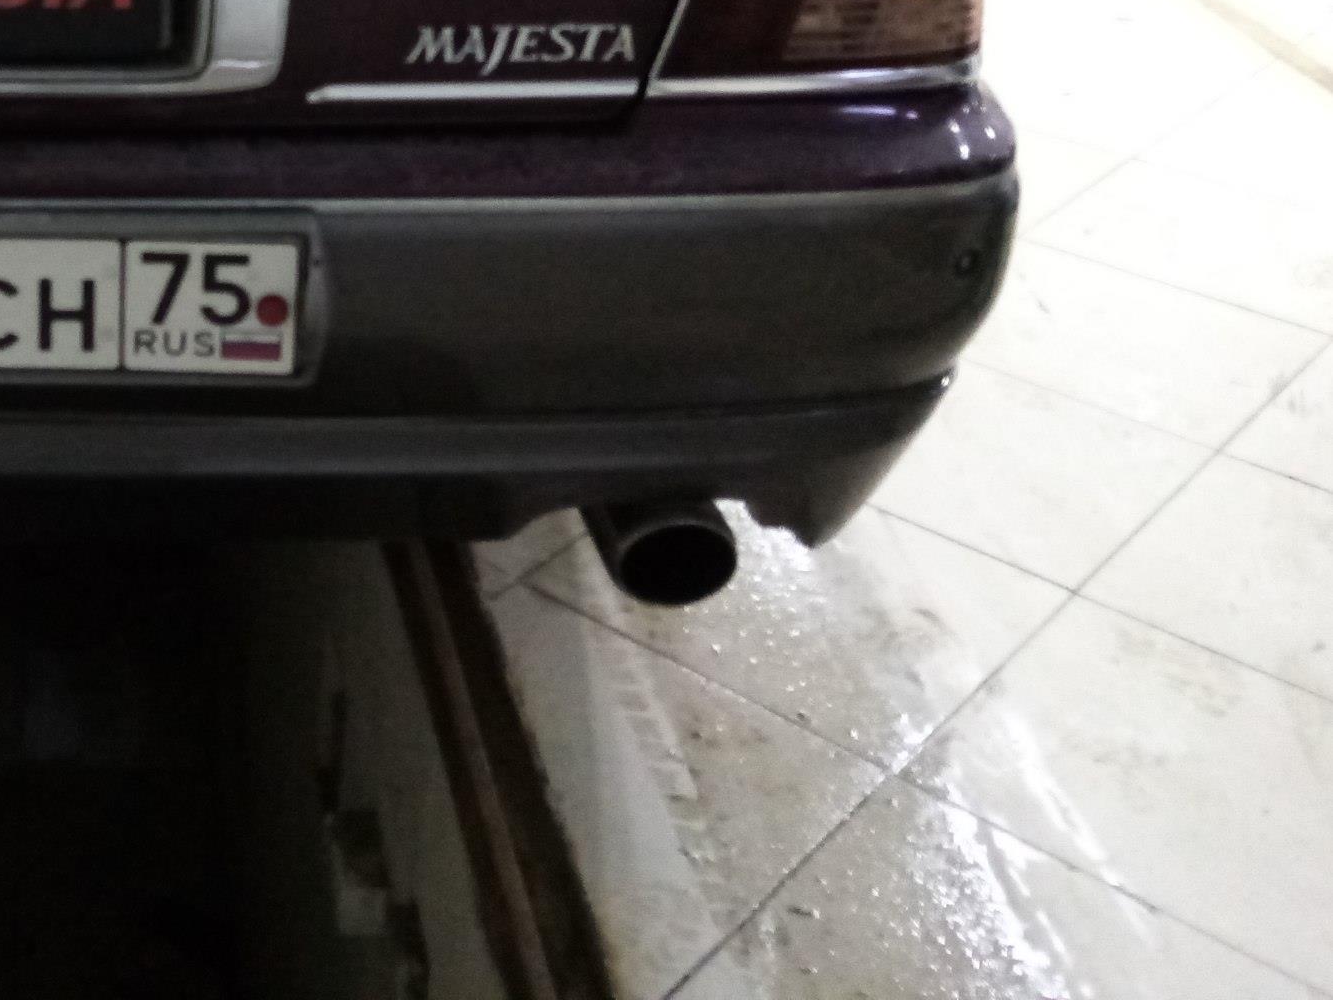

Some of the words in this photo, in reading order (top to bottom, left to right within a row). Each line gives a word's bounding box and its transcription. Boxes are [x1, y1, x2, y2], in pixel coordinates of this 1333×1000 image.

[404, 23, 635, 76] MAJESTA
[141, 252, 252, 327] 75
[132, 328, 216, 358] RUS
